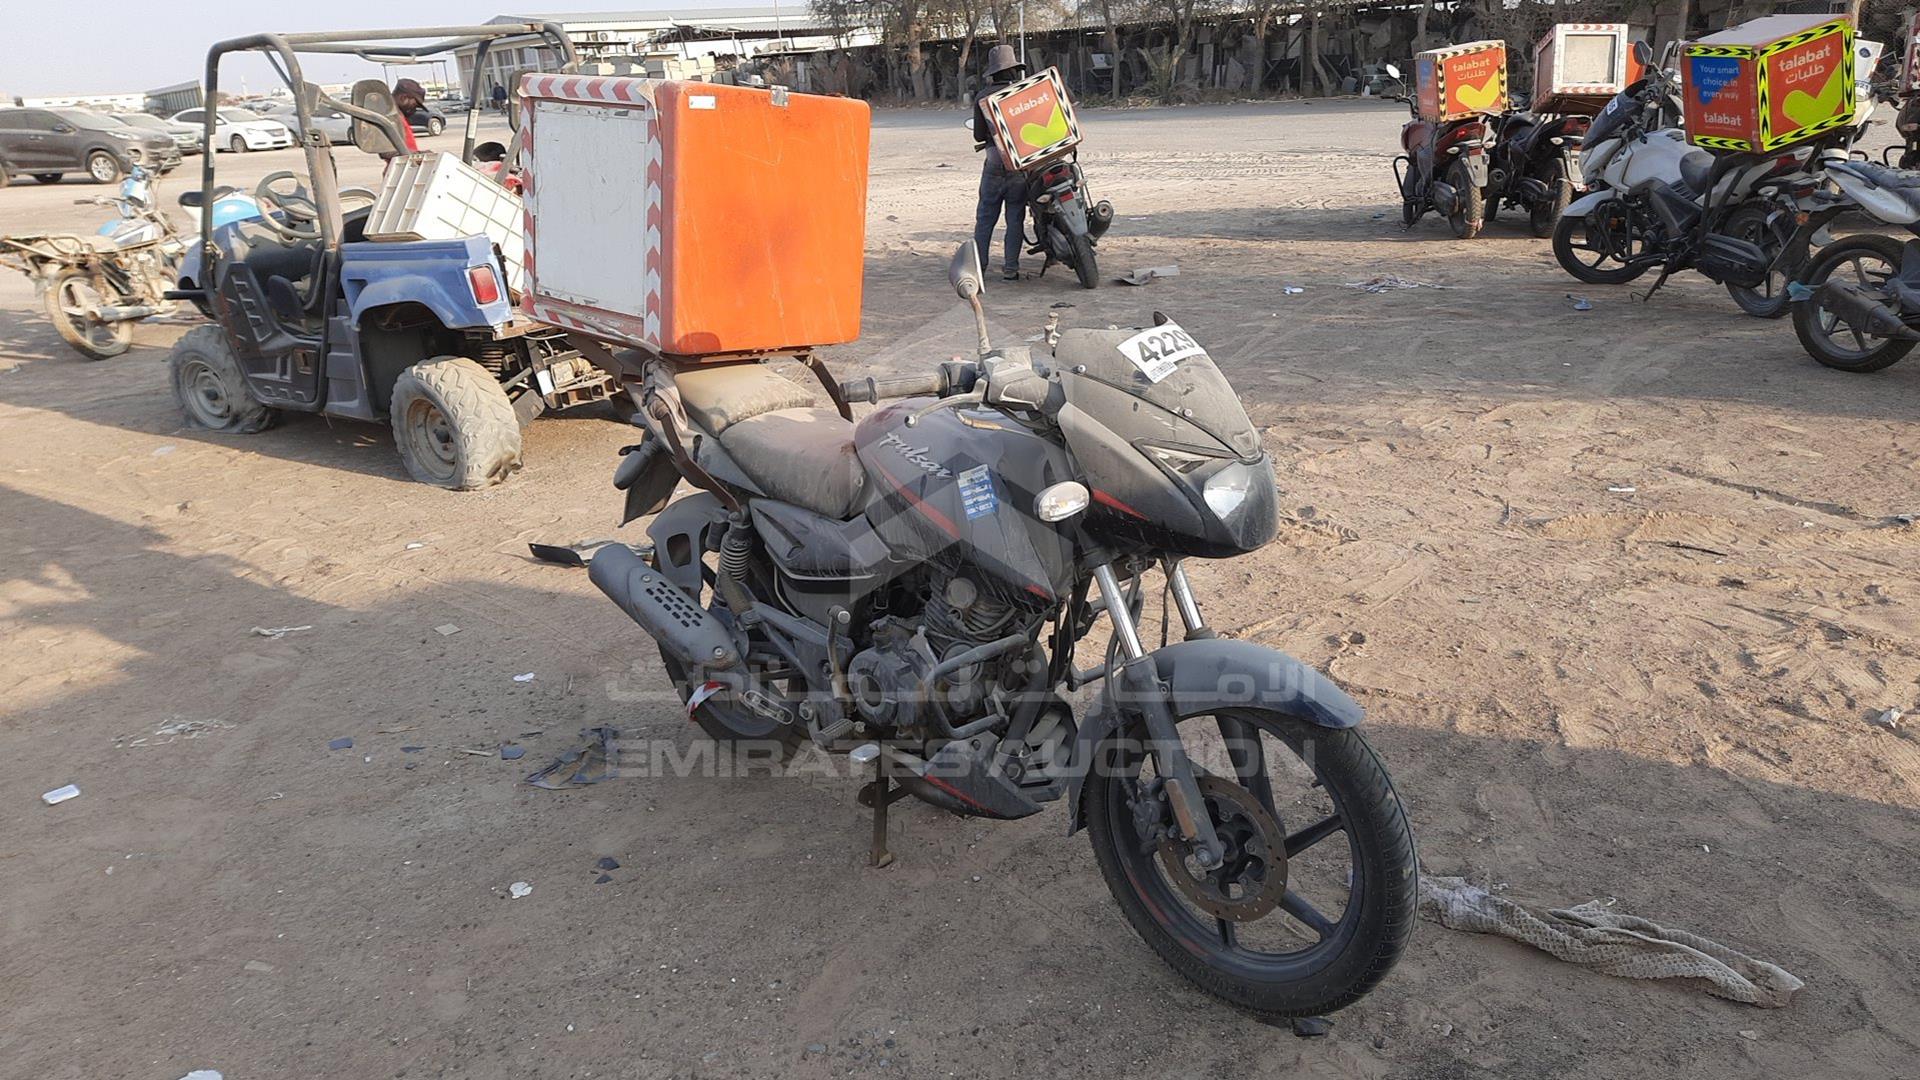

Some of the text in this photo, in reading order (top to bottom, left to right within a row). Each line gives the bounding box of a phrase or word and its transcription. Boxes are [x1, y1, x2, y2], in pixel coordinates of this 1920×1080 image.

[1452, 57, 1491, 73] talabat
[1778, 44, 1831, 72] talabat
[1700, 64, 1739, 74] Your smart
[1785, 63, 1825, 84] طلبات
[1703, 90, 1722, 100] every
[1007, 92, 1050, 117] talabat
[1703, 112, 1742, 126] talabat
[1138, 330, 1195, 363] 4229
